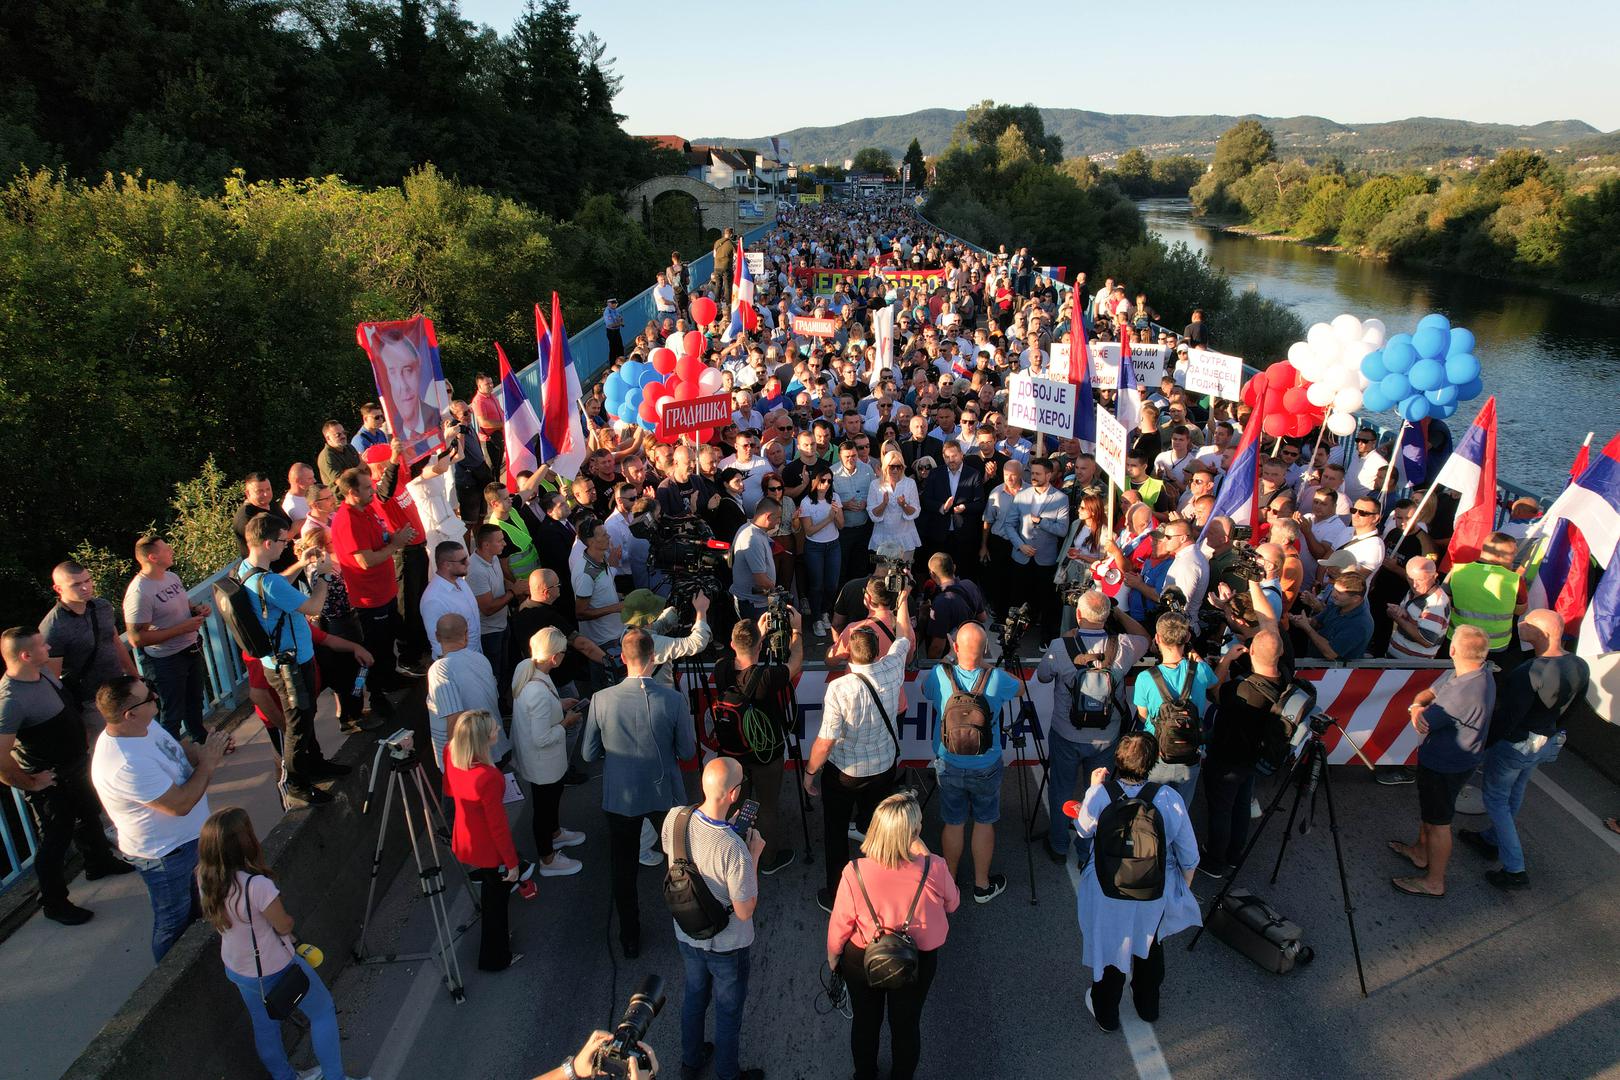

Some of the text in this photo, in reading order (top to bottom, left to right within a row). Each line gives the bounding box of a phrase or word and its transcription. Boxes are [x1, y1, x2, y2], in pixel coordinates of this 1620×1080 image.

[795, 319, 832, 334] ГРАДИШКА
[1018, 381, 1066, 404] ДОБОЈ ЈЕ
[666, 400, 728, 429] ГРАДИШКА
[1012, 403, 1071, 430] ГРАД ХЕРОЈ
